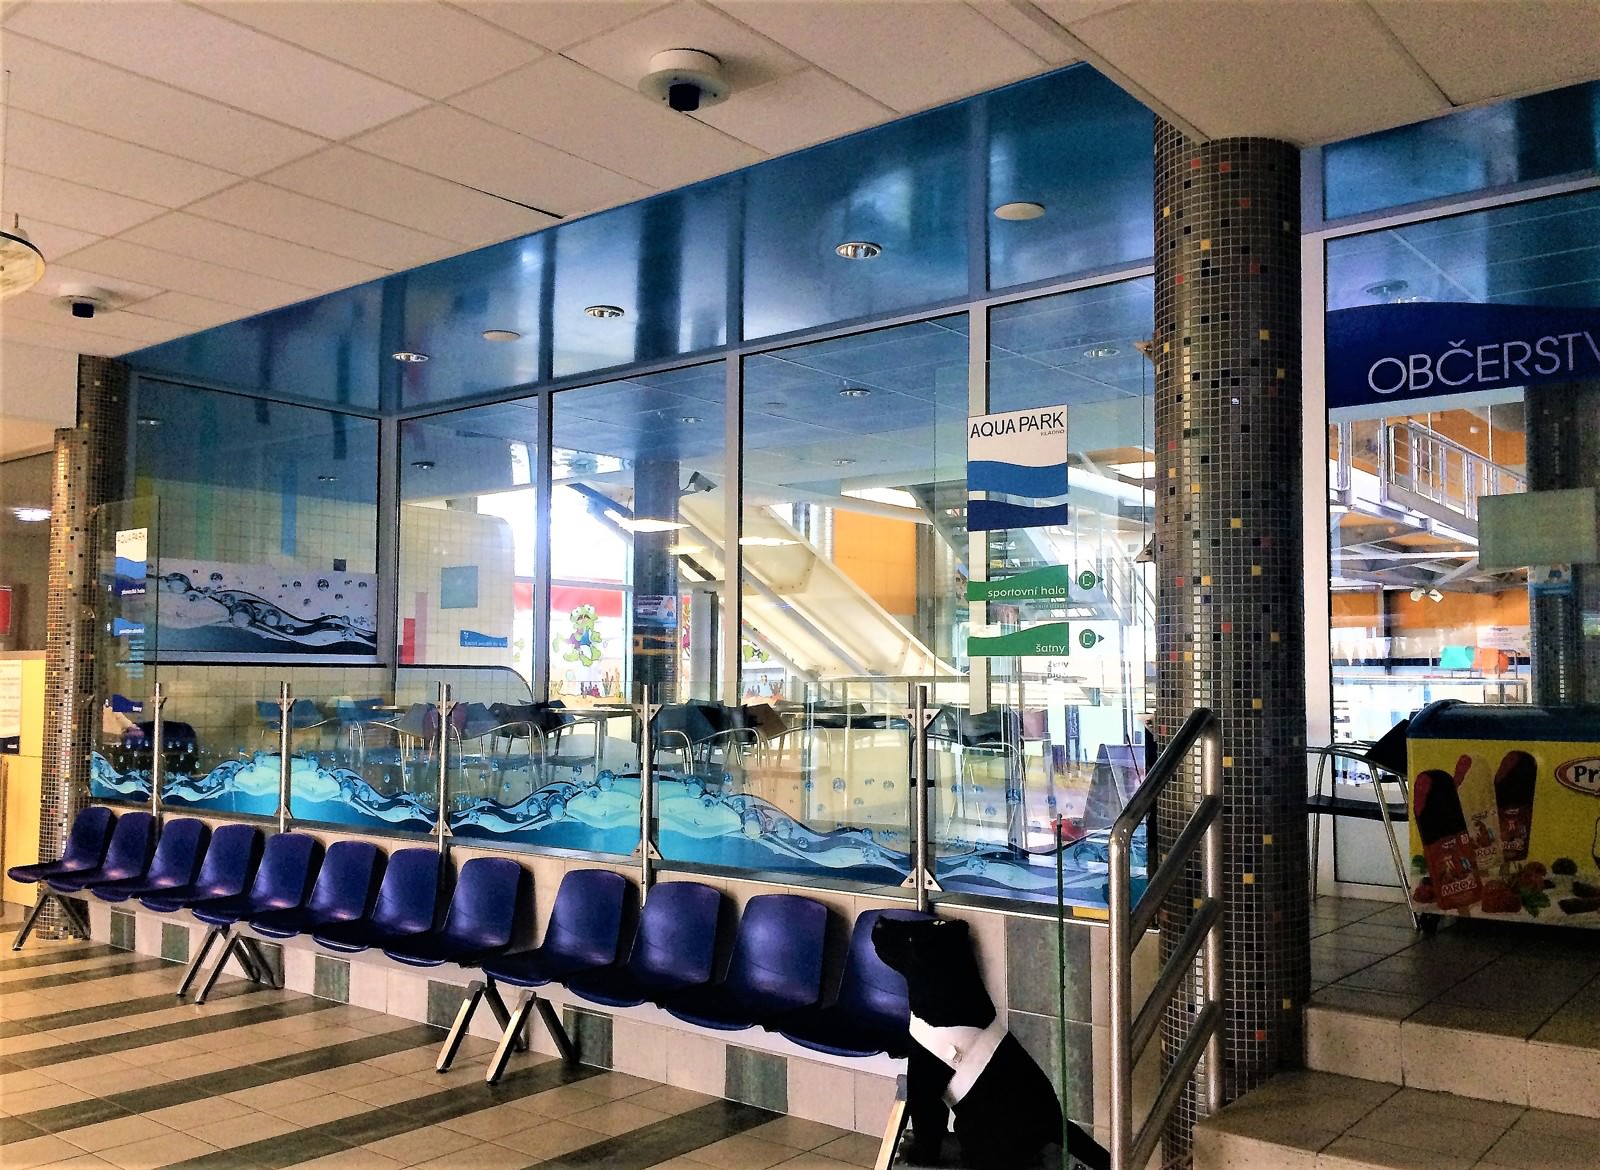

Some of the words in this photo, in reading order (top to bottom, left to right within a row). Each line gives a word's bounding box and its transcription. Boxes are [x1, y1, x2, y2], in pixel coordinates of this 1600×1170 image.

[970, 419, 1016, 438] AQUA
[1019, 411, 1064, 432] PARK
[988, 586, 1037, 598] sportovní
[1041, 586, 1065, 595] hala
[1035, 643, 1066, 654] šatny
[1574, 765, 1600, 783] Pr
